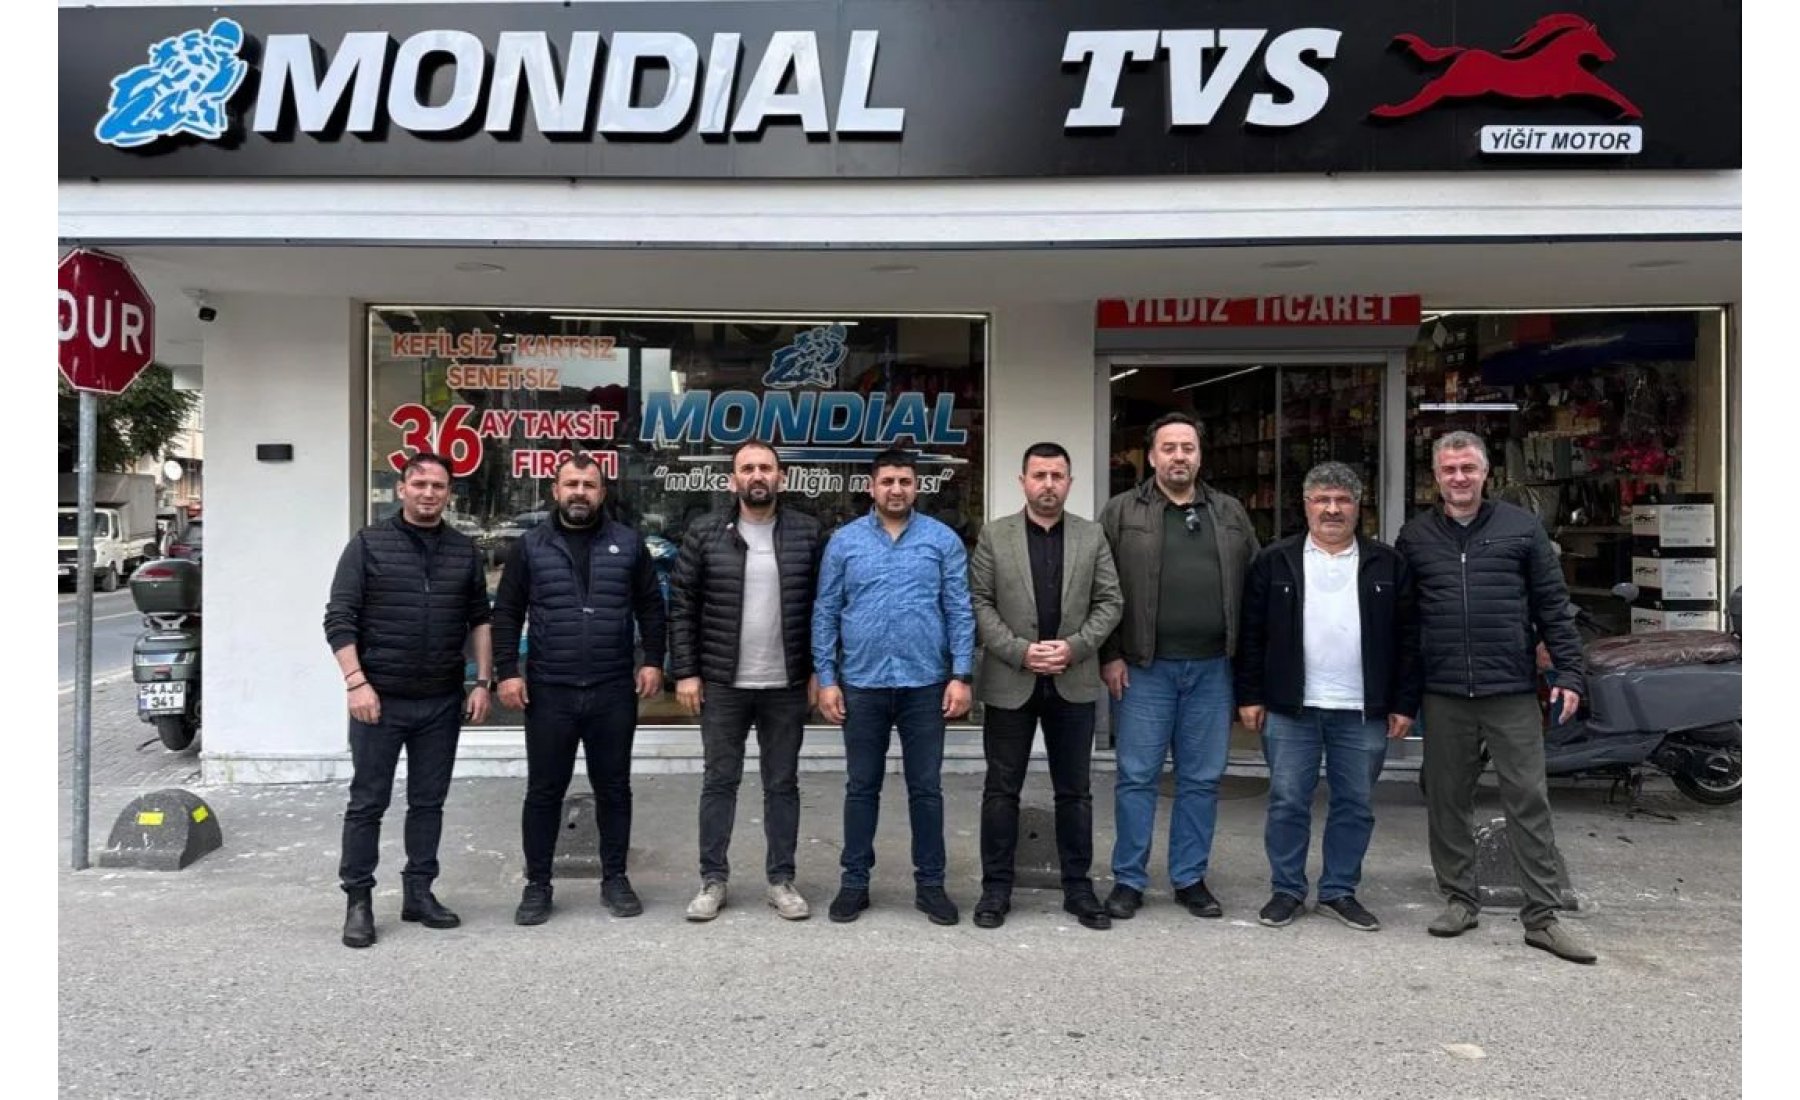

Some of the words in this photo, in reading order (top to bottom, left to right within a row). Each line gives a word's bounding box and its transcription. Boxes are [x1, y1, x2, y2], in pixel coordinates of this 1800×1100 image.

[253, 29, 905, 133] MONDIAL
[1061, 27, 1342, 127] TVS
[1492, 128, 1547, 150] YİĞİT
[1551, 132, 1632, 150] MOTOR
[391, 328, 497, 357] KEFİLSİZ
[514, 335, 617, 359] KARTSIZ
[480, 410, 519, 439] AY
[519, 406, 619, 439] TAKSİT
[387, 402, 483, 477] 36
[512, 449, 618, 480] FIRTI
[140, 683, 157, 695] 54
[151, 696, 175, 708] 341
